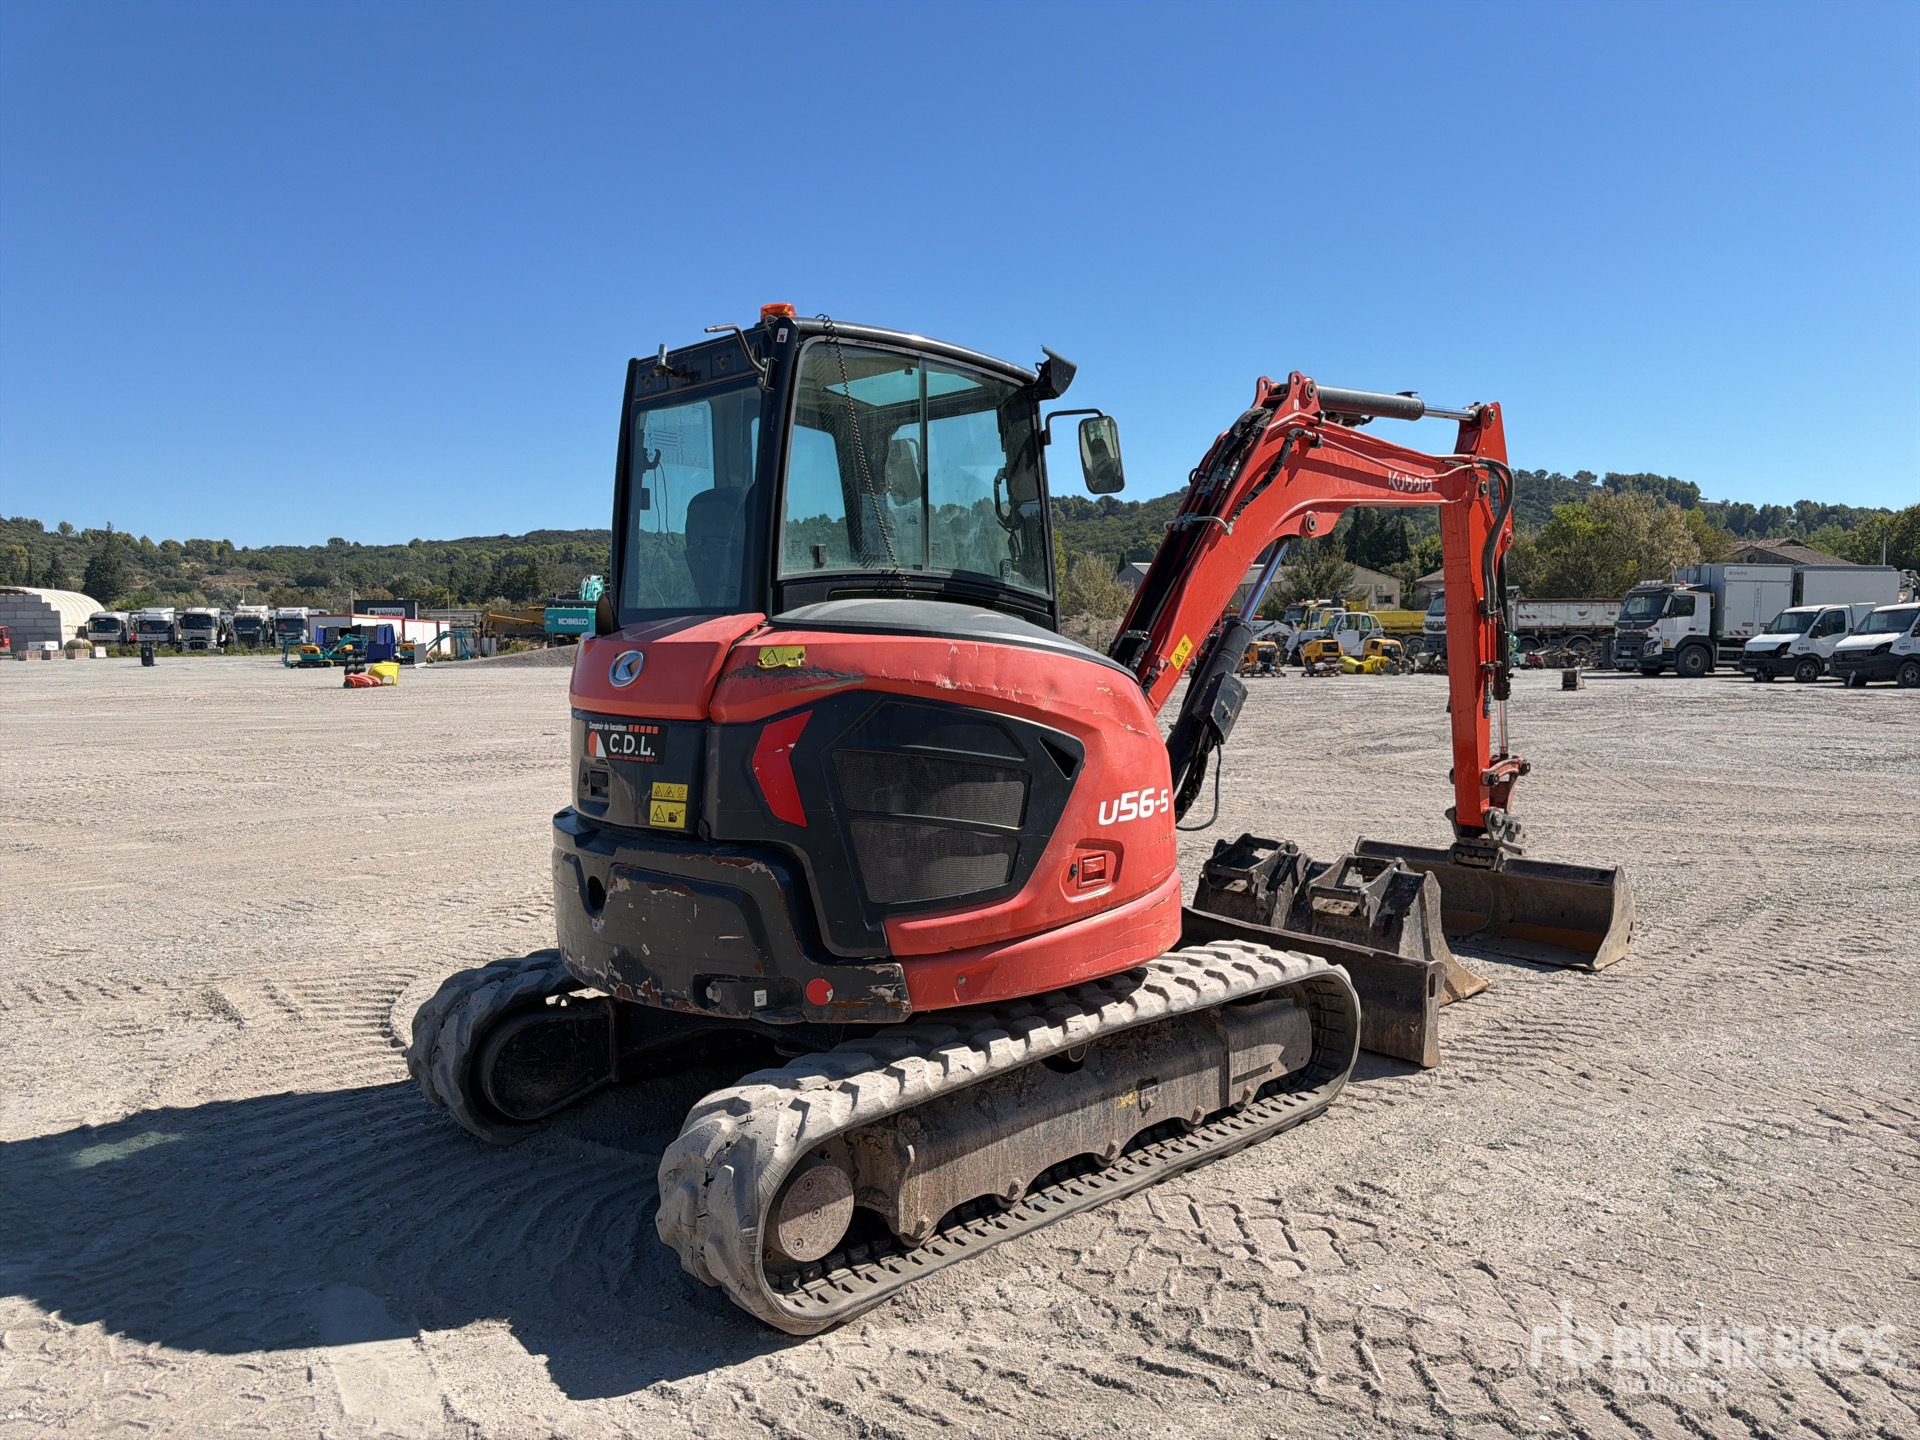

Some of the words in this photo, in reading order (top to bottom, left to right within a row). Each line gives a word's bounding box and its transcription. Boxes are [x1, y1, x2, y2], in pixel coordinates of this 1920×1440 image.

[1388, 470, 1433, 492] Kubota
[558, 617, 589, 626] KOBELCO
[609, 733, 656, 757] C.D.L.
[1098, 787, 1169, 826] U56-5
